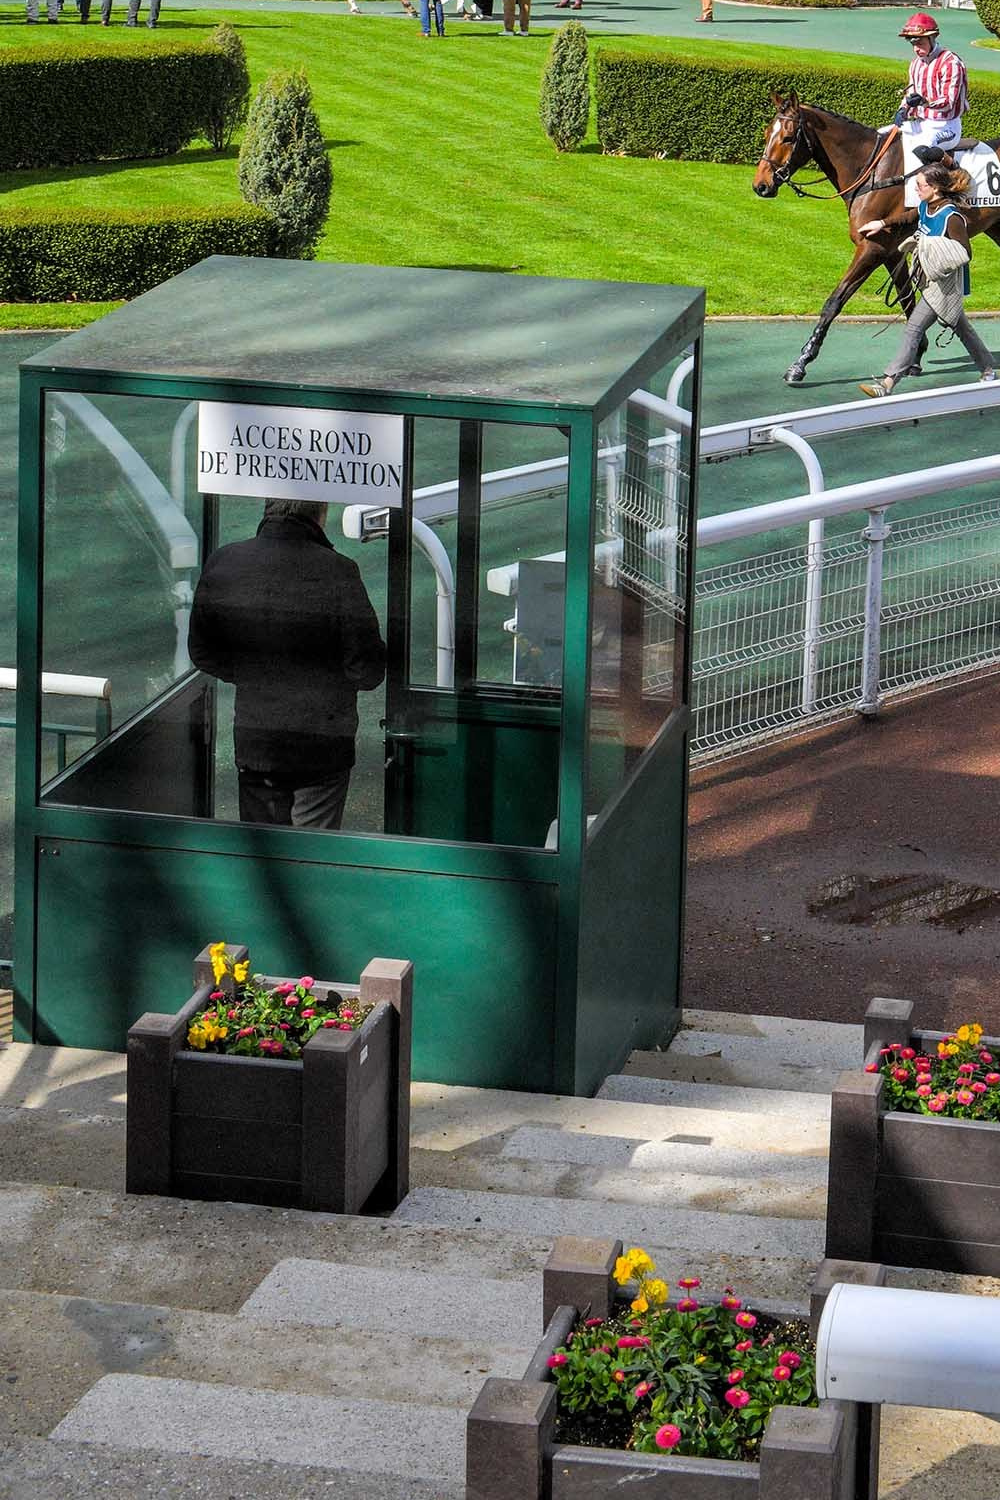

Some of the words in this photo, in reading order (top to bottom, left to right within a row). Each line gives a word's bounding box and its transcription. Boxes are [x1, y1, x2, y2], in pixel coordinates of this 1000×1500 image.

[230, 424, 303, 452] ACCES
[309, 429, 372, 456] ROND
[200, 451, 228, 475] DE
[235, 453, 402, 488] PRESENTATION
